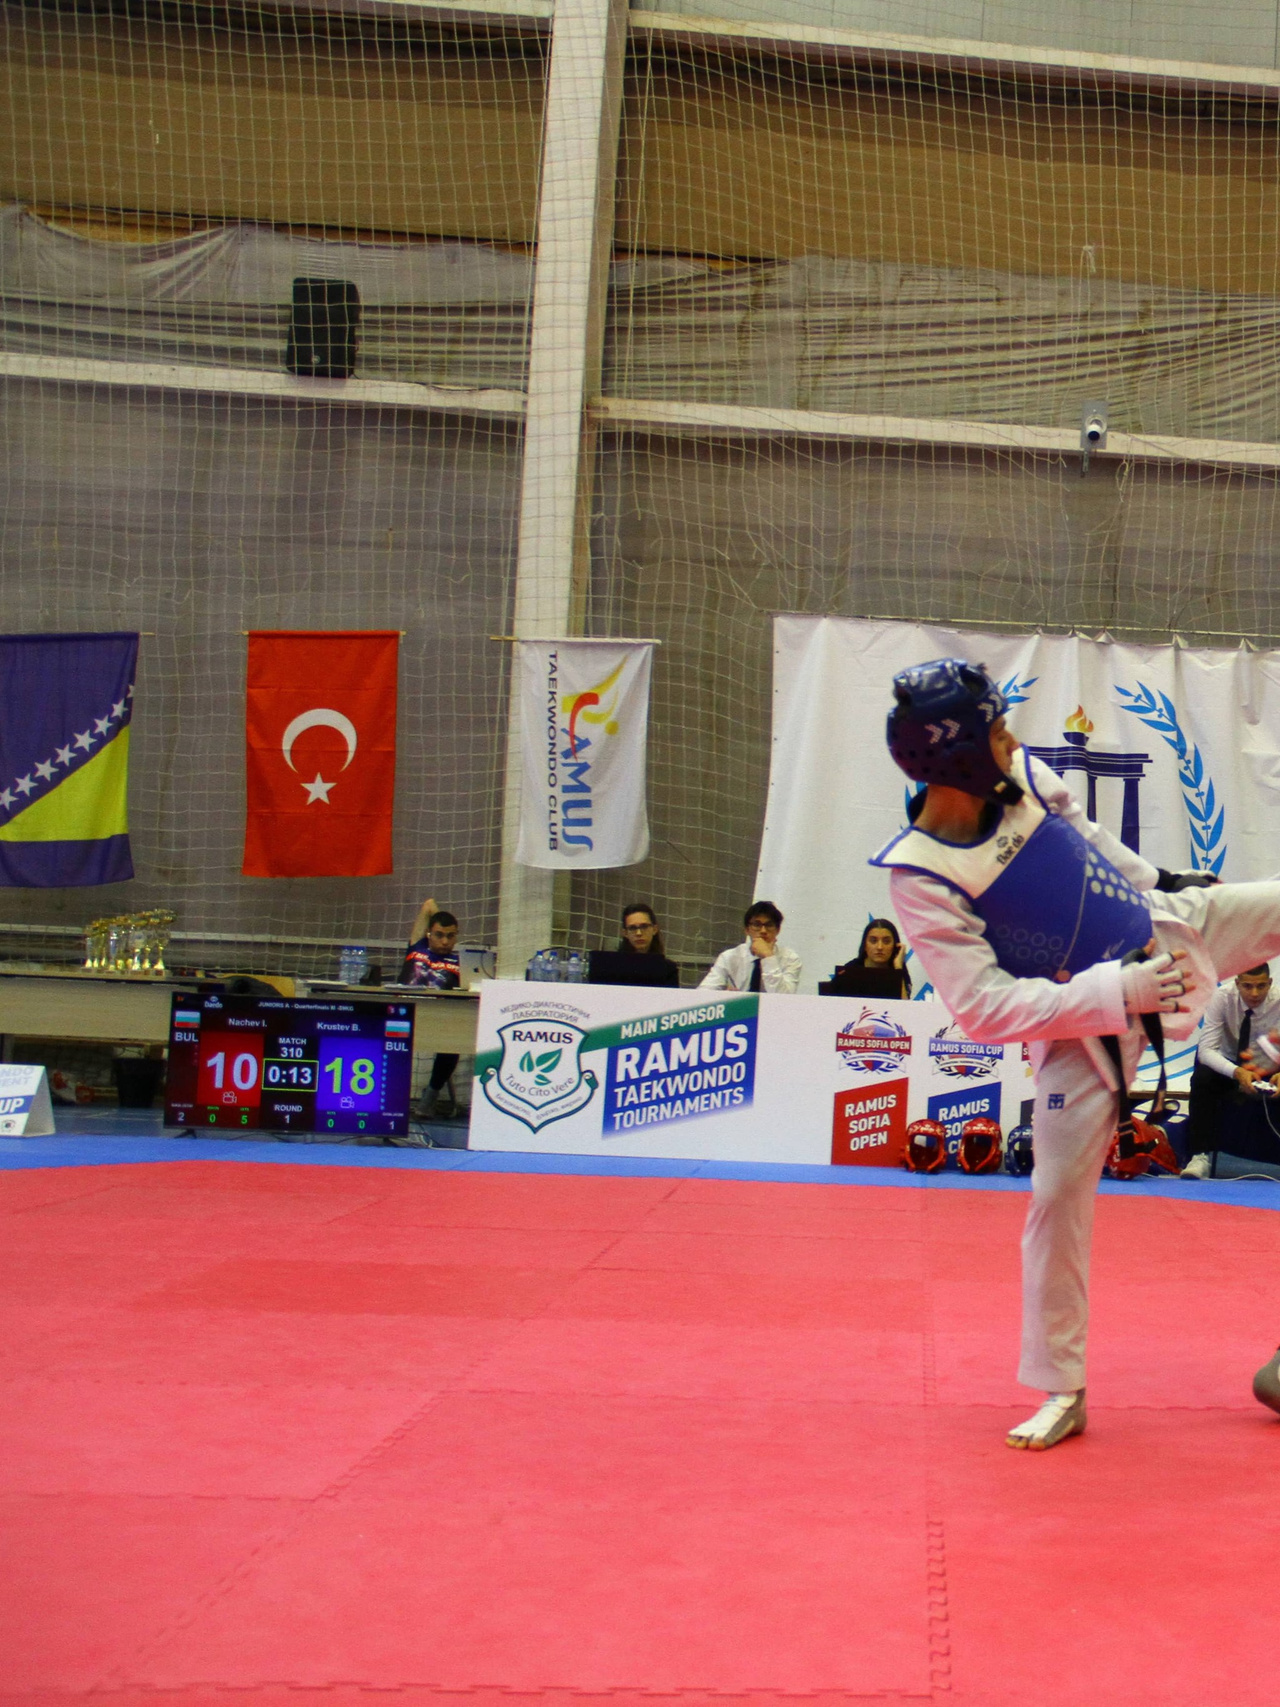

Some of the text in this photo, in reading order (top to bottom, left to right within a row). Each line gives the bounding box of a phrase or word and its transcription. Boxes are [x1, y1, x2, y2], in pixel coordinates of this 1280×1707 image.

[547, 650, 558, 851] TAEKWONDO CLUB
[512, 1009, 579, 1023] ЛАБОРАТОРИЯ
[620, 1004, 725, 1040] MAIN SPONSOR
[228, 1018, 260, 1028] Nachev
[317, 1022, 361, 1032] Krustev B.
[175, 1031, 199, 1042] BUL
[279, 1037, 307, 1045] MATCH
[512, 1030, 573, 1044] RAMUS
[385, 1041, 409, 1052] BUL
[837, 1038, 910, 1050] RAMUS SOFIA OPEN
[930, 1043, 1003, 1055] RAMUS SOFIA CUP
[281, 1047, 303, 1058] 310
[616, 1023, 748, 1083] RAMUS
[207, 1051, 258, 1090] 10
[268, 1066, 312, 1084] 0:13
[325, 1057, 375, 1095] 18
[505, 1073, 575, 1097] Tuto Cito Vere
[614, 1061, 746, 1108] TAEKWONDO
[0, 1098, 25, 1114] UP
[274, 1104, 303, 1112] ROUND
[612, 1086, 744, 1131] TOURNAMENTS
[845, 1094, 897, 1118] RAMUS
[938, 1098, 990, 1122] RAMUS
[178, 1112, 185, 1121] 2
[209, 1114, 216, 1123] 0
[241, 1115, 248, 1124] 5
[284, 1114, 290, 1124] 1
[327, 1118, 335, 1128] 0
[358, 1120, 366, 1129] 0
[389, 1120, 396, 1130] 1
[848, 1113, 891, 1134] SOFIA
[850, 1131, 888, 1151] OPEN
